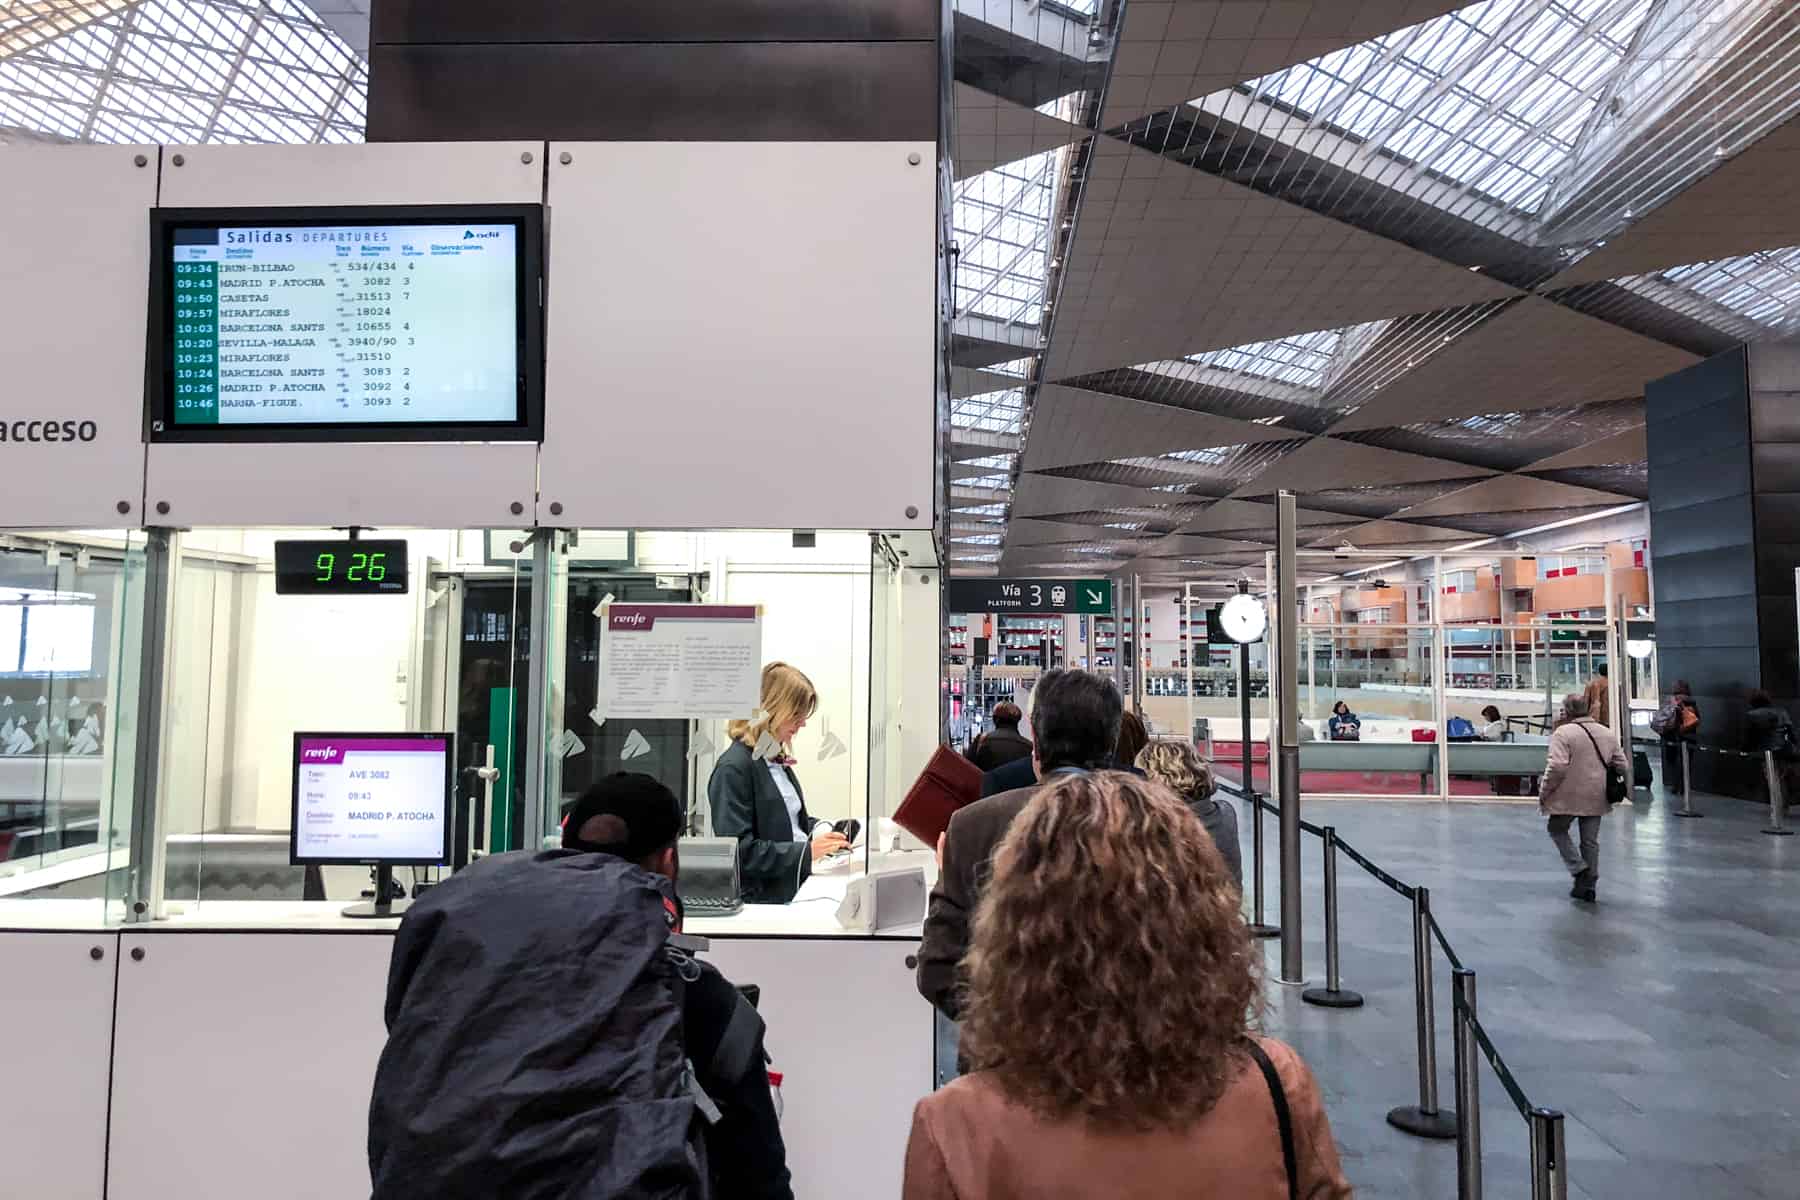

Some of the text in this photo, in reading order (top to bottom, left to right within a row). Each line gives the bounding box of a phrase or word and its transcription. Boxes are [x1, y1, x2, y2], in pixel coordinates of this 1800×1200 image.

[227, 230, 388, 243] Salidas DEPARTURES
[177, 265, 212, 273] 09:34
[219, 264, 295, 272] IRUN-BILBAO
[348, 262, 397, 271] 534/434
[408, 262, 414, 270] 4
[177, 277, 410, 288] 09:43 MADRID P.ATOCHA 3082 3
[177, 295, 213, 303] 09:50
[220, 294, 269, 302] CASETAS
[356, 292, 391, 301] 31513
[403, 292, 410, 300] 7
[177, 309, 213, 318] 09:57
[220, 309, 290, 317] MIRAFLORES
[357, 307, 391, 316] 18024
[177, 324, 213, 333] 10:03
[220, 324, 283, 332] BARCELONA
[290, 323, 325, 331] SANTS
[357, 322, 391, 331] 10655
[403, 322, 410, 330] 4
[177, 339, 213, 348] 10:20
[219, 339, 316, 347] SEVILLA-MALAGA
[347, 337, 397, 346] 3940/90
[408, 337, 415, 345] 3
[177, 355, 213, 363] 10:23
[220, 354, 290, 362] MIRAFLORES
[356, 352, 391, 360] 31510
[177, 367, 410, 378] 10:24 BARCELONA SANTS 3083 2
[177, 382, 410, 393] 10:26 MADRID P.ATOCHA 3092 4
[177, 399, 213, 408] 10:46
[363, 397, 391, 406] 3093
[403, 397, 410, 405] 2
[316, 553, 386, 581] 9 26
[1002, 584, 1042, 606] Vía 3
[613, 612, 646, 626] renfe
[305, 746, 337, 760] renfe
[349, 771, 367, 779] AVE
[347, 812, 384, 820] MADRID
[386, 812, 395, 820] P.
[397, 812, 435, 820] ATOCHA
